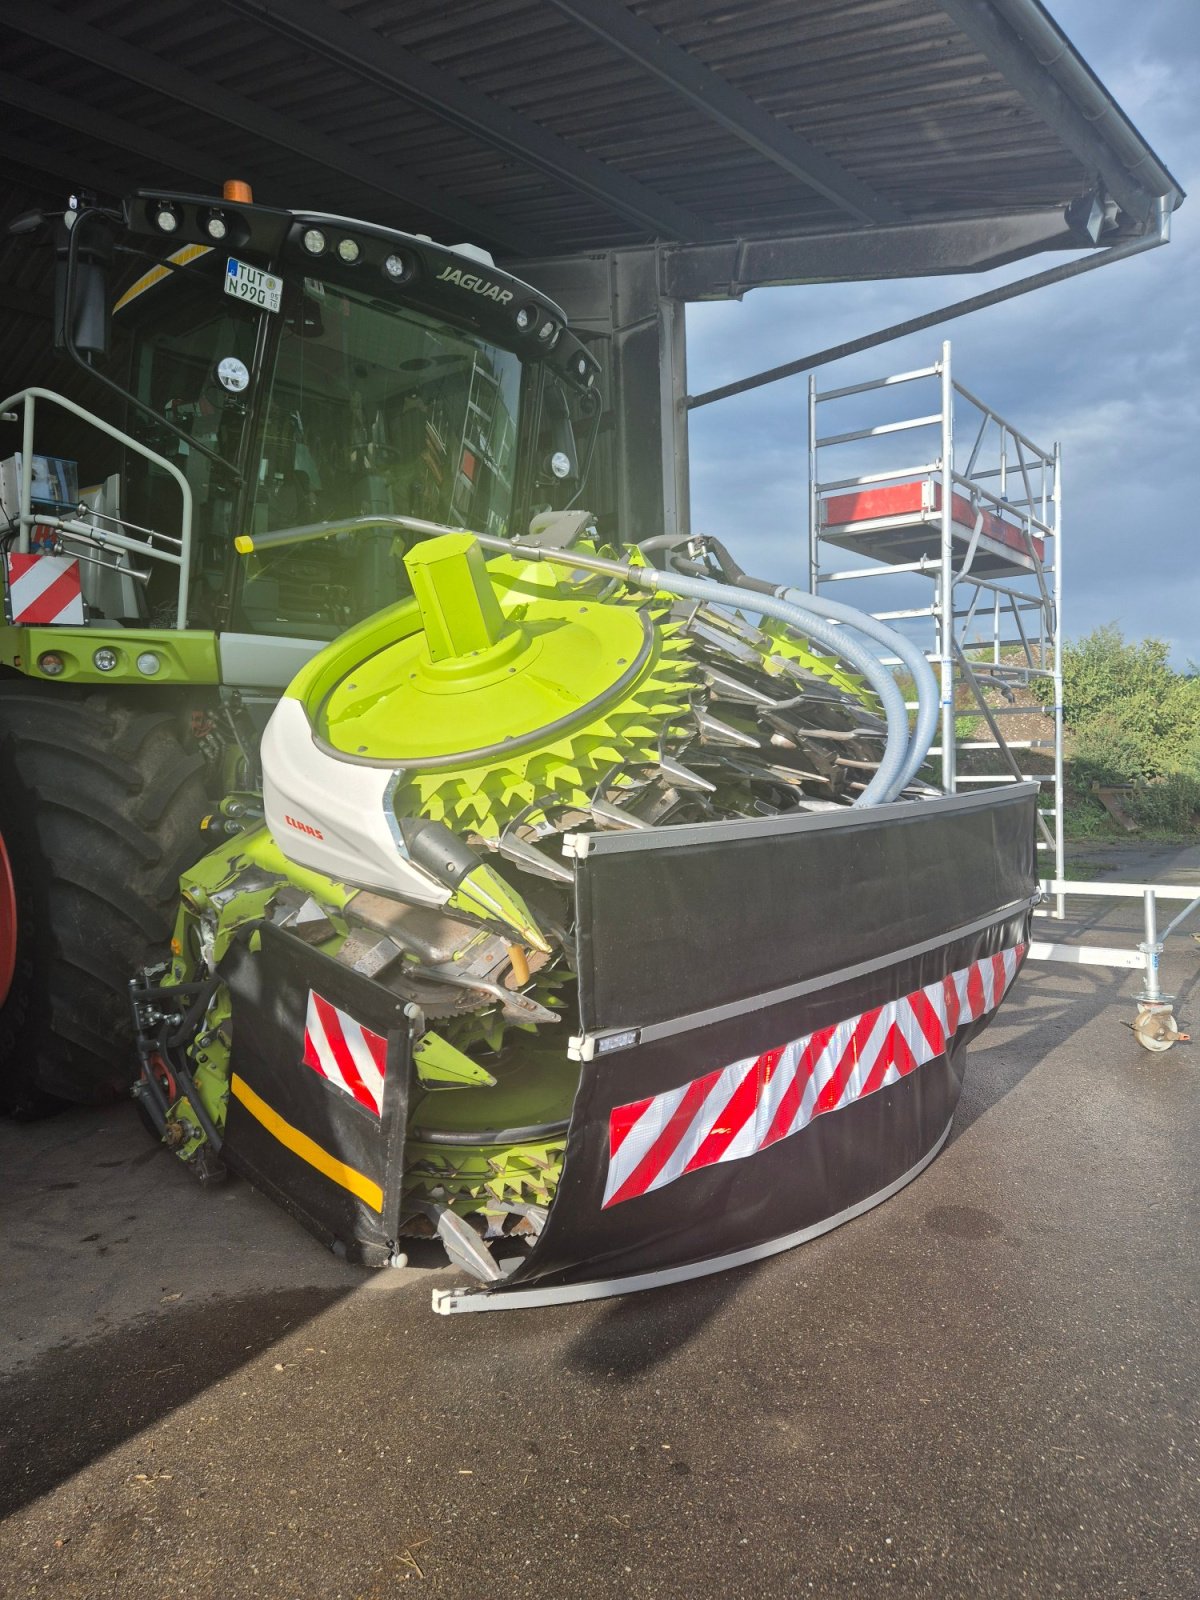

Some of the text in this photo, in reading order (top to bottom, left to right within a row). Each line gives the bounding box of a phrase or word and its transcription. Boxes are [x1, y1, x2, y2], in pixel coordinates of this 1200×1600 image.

[239, 264, 265, 287] TUT
[436, 266, 514, 305] JAGUAR
[229, 278, 266, 305] N 990
[285, 815, 324, 840] CLAAS
